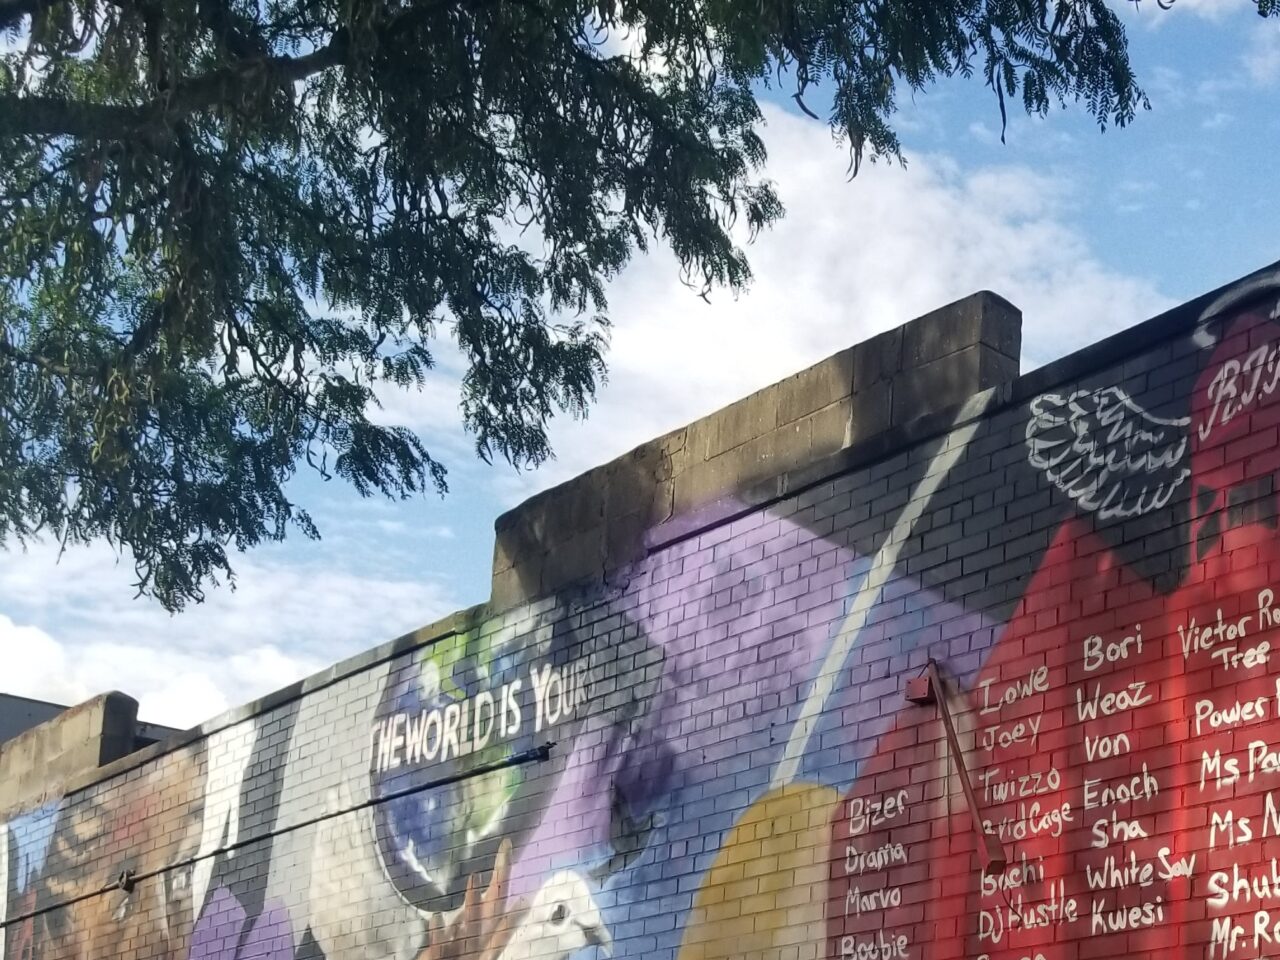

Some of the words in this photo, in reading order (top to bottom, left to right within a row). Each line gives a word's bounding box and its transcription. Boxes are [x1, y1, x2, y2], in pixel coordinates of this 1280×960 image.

[1083, 624, 1143, 671] Bori
[500, 679, 522, 738] IS
[1195, 697, 1269, 735] Power
[982, 713, 1042, 751] Joey
[1084, 762, 1158, 810] Enoch
[1200, 749, 1240, 793] Ms
[1091, 808, 1148, 848] Sha
[1209, 809, 1253, 852] Ms
[845, 842, 907, 876] Drama
[1091, 895, 1164, 936] Kwesi
